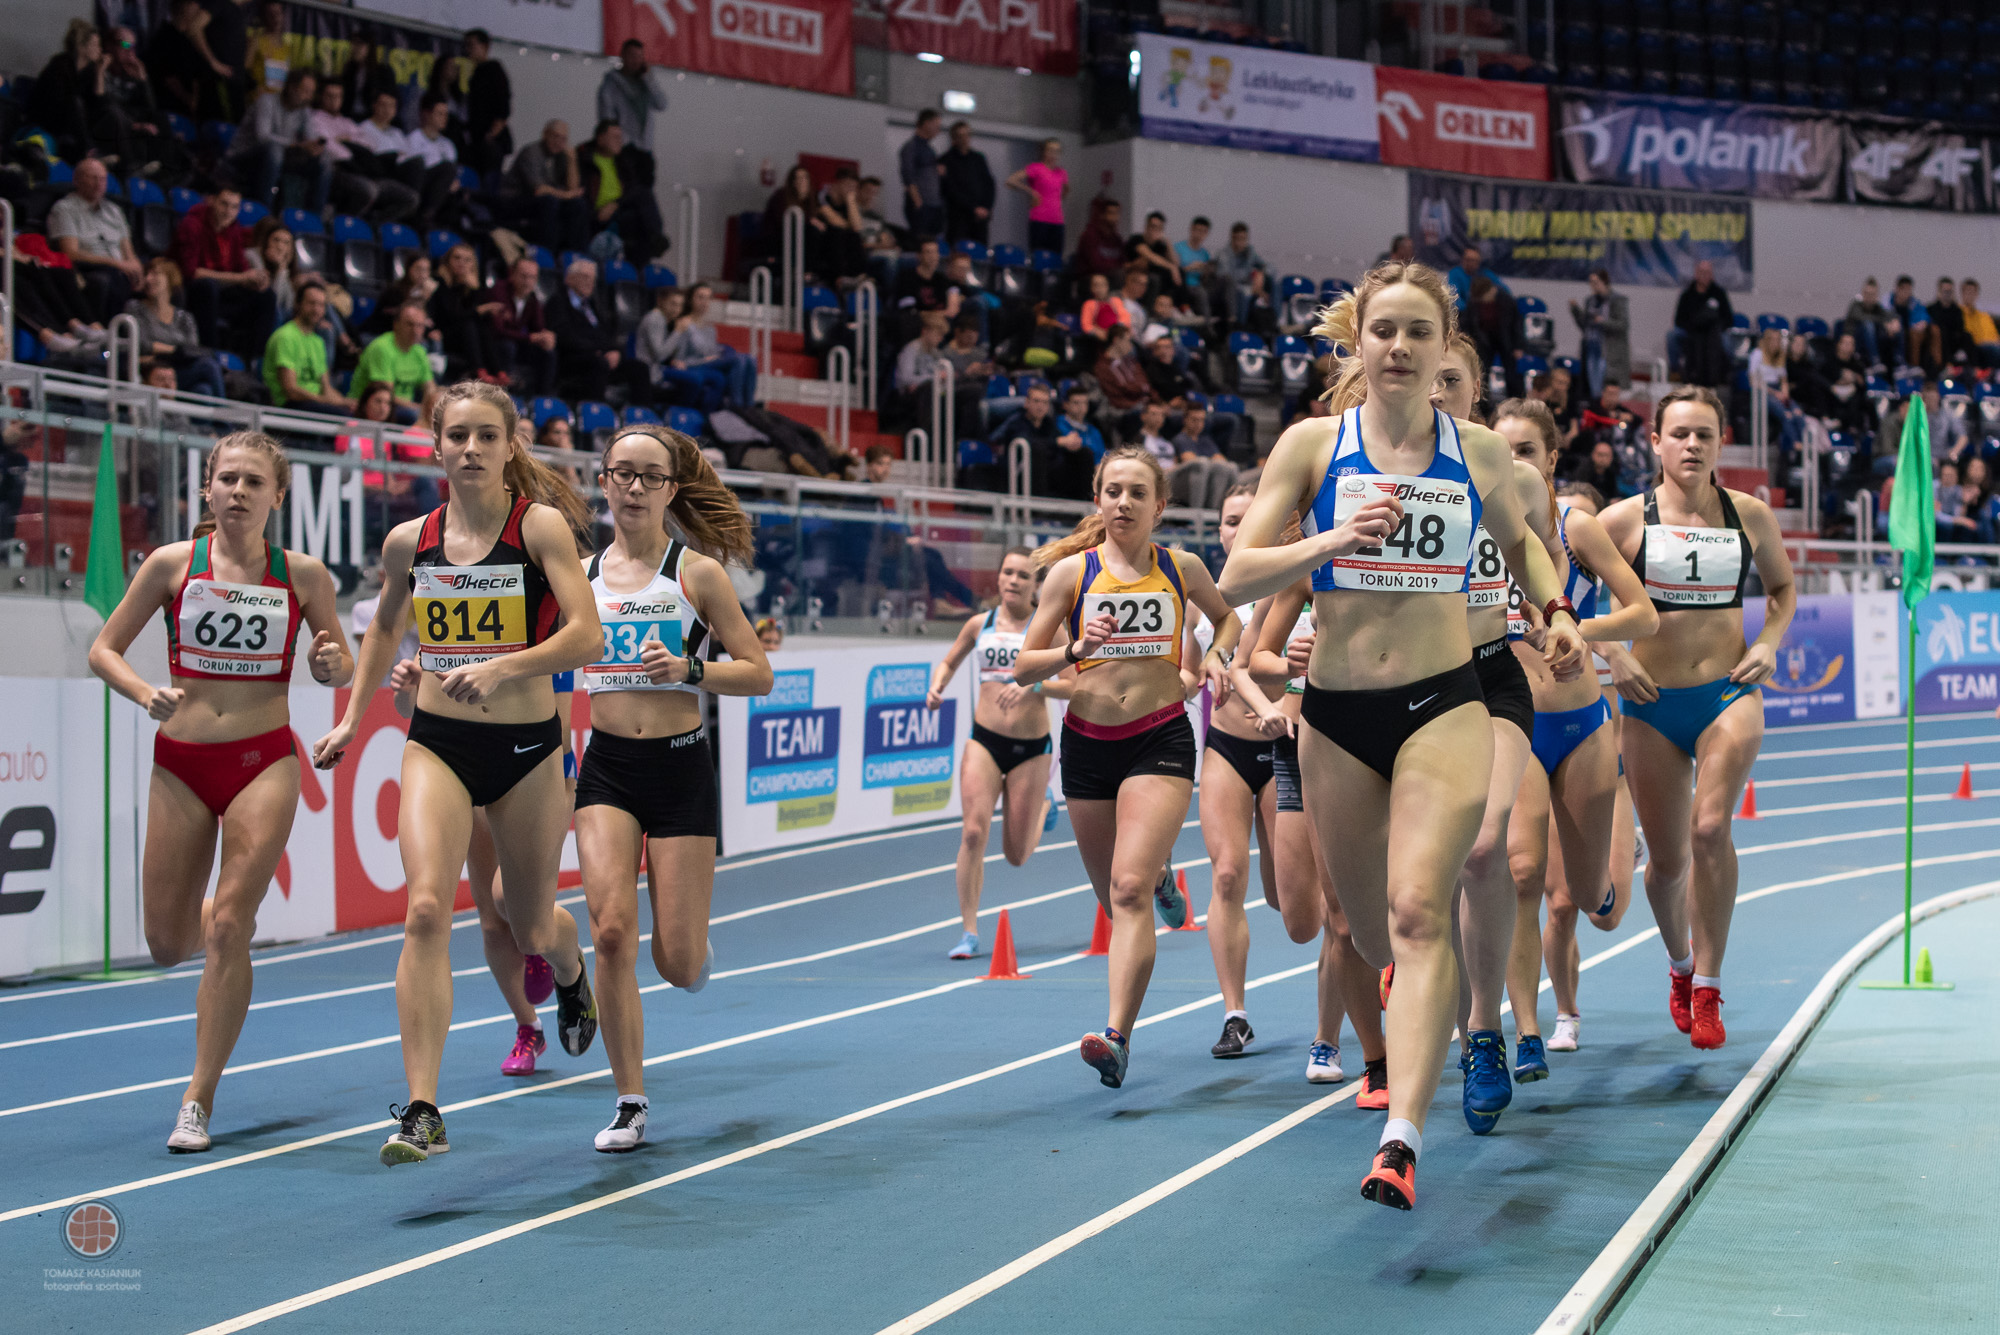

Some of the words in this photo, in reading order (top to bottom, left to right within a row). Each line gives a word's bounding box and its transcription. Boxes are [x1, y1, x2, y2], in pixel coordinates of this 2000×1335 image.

[718, 6, 818, 47] ORLEN
[1443, 110, 1528, 141] ORLEN
[1628, 117, 1811, 174] polanik
[1356, 513, 1446, 560] 48
[1685, 550, 1702, 582] 1
[1360, 572, 1403, 587] TORUŃ
[1407, 576, 1438, 589] 2019
[1474, 592, 1500, 603] 2019
[1663, 591, 1695, 601] TORUŃ
[1697, 593, 1718, 601] 2019
[427, 599, 504, 642] 814
[1097, 598, 1163, 633] 223
[195, 611, 268, 650] 623
[434, 655, 469, 668] TORUŃ
[1102, 644, 1136, 655] TORUŃ
[1138, 644, 1162, 654] 2019
[1480, 642, 1504, 660] NIKE
[198, 658, 233, 671] TORUŃ
[236, 663, 262, 673] 2019
[601, 672, 632, 685] TORUŃ
[635, 674, 648, 684] 20
[1937, 673, 1997, 700] TEAM
[879, 707, 941, 747] TEAM
[1151, 706, 1179, 723] ELBRUS
[670, 733, 695, 748] NIKE
[762, 715, 825, 759] TEAM
[0, 742, 48, 783] auto
[865, 756, 951, 783] CHAMPIONSHIPS
[750, 768, 835, 797] CHAMPIONSHIPS
